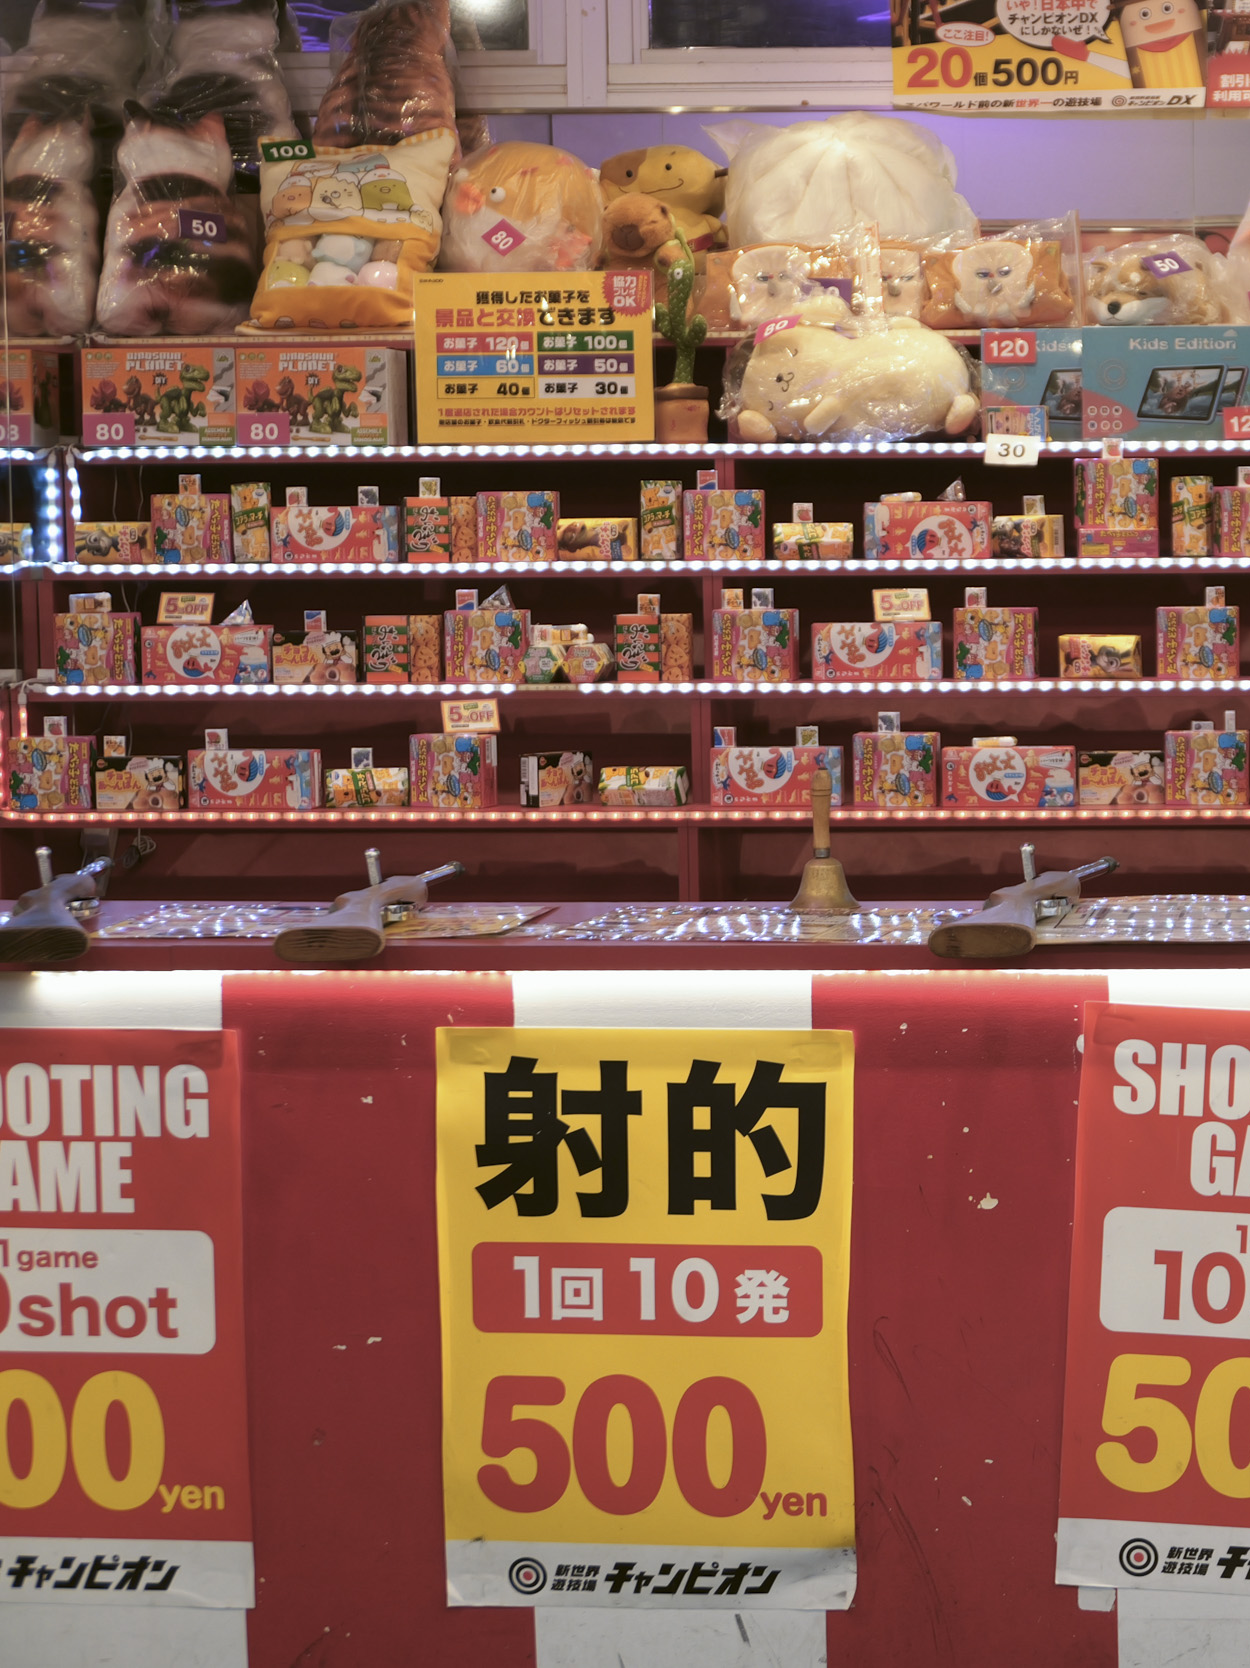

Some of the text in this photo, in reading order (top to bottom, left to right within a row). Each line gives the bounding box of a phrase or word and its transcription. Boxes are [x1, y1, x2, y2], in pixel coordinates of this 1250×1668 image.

[269, 144, 310, 159] 100
[191, 220, 218, 237] 50
[492, 229, 515, 251] 80
[1157, 257, 1179, 272] 50
[476, 289, 590, 304] 獲得したお菓子を
[613, 295, 637, 307] OK
[435, 307, 616, 327] 景品と交換できます
[765, 319, 788, 336] 80
[989, 340, 1029, 358] 120
[1129, 337, 1237, 351] Kids Edition
[125, 360, 184, 371] PLANET
[278, 361, 336, 372] PLANET
[95, 423, 124, 440] 80
[250, 423, 279, 440] 80
[998, 443, 1026, 458] 30
[0, 1063, 210, 1139] OTING
[475, 1056, 827, 1221] 射的
[0, 1270, 178, 1340] shot
[1166, 1546, 1215, 1561] 新世界
[7, 1555, 181, 1591] チャンピオン
[555, 1564, 601, 1578] 新世界
[1160, 1560, 1210, 1576] 遊技場
[550, 1578, 598, 1593] 遊技場
[604, 1561, 783, 1595] チャンピオン
